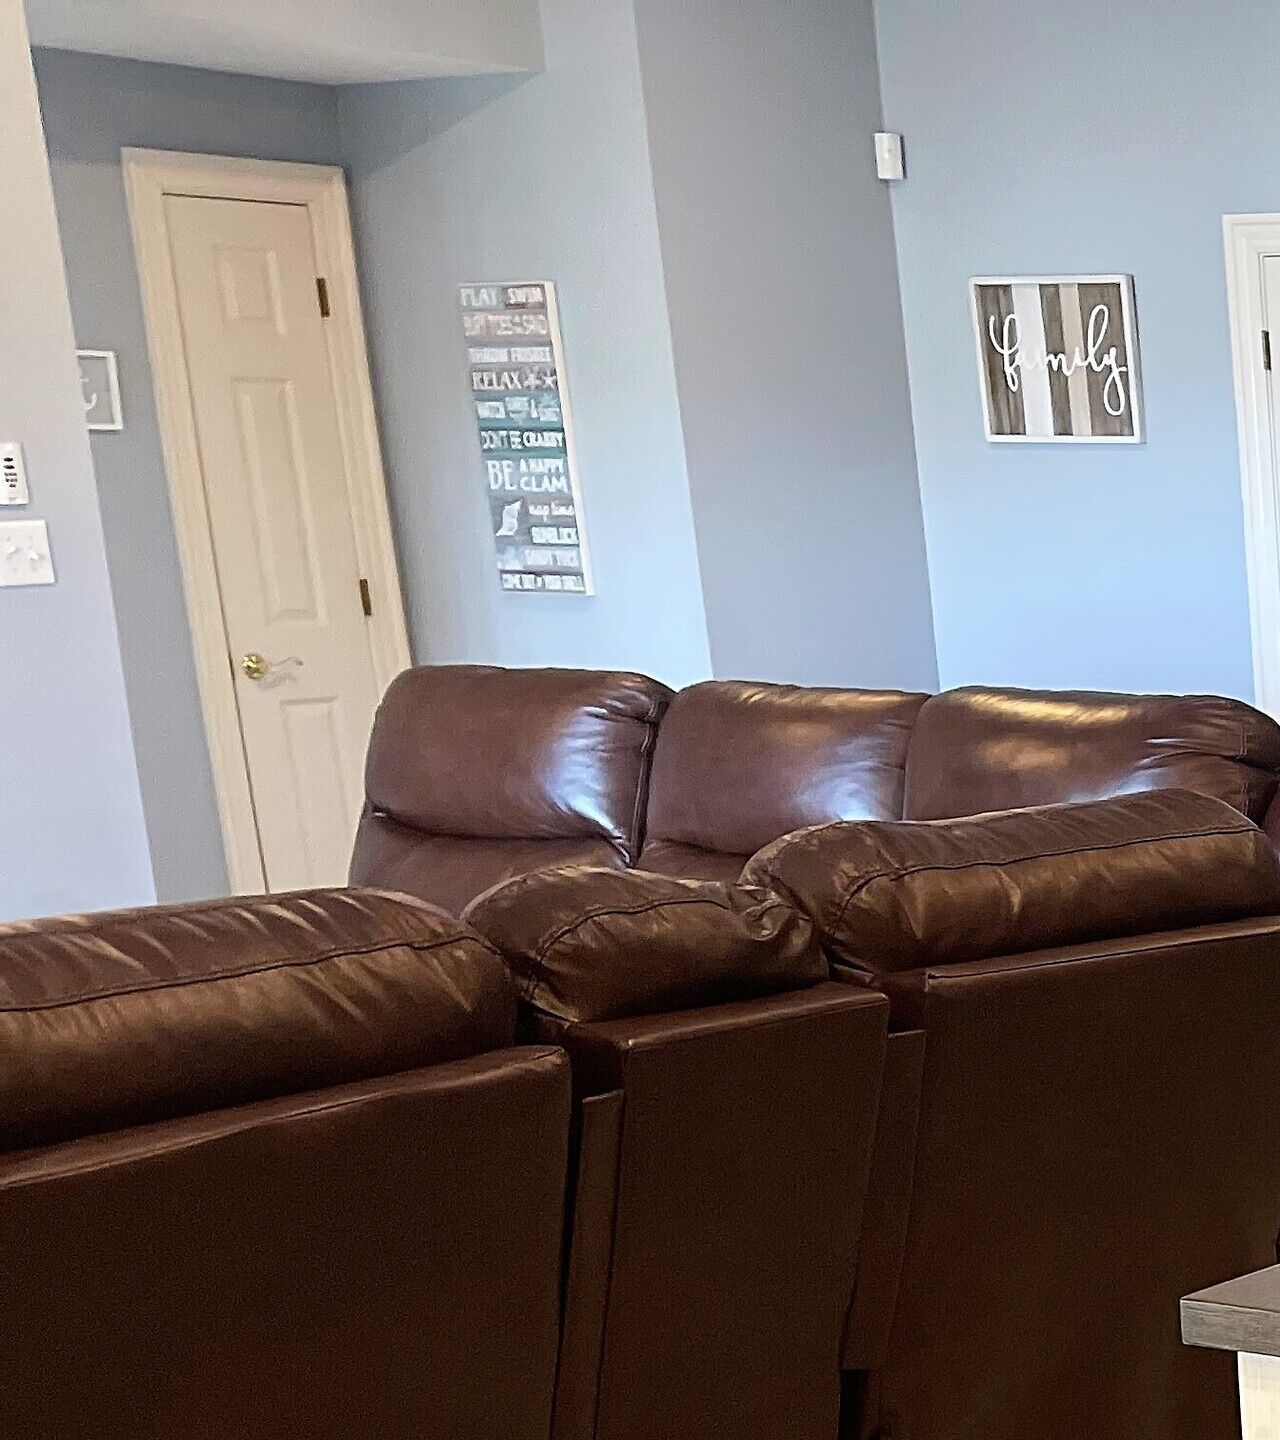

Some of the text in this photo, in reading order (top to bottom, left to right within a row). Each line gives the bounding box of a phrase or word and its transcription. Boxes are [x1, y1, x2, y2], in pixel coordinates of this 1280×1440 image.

[989, 304, 1127, 416] family
[472, 371, 522, 390] RELAX
[487, 459, 518, 491] BE
[520, 475, 568, 493] CLAM
